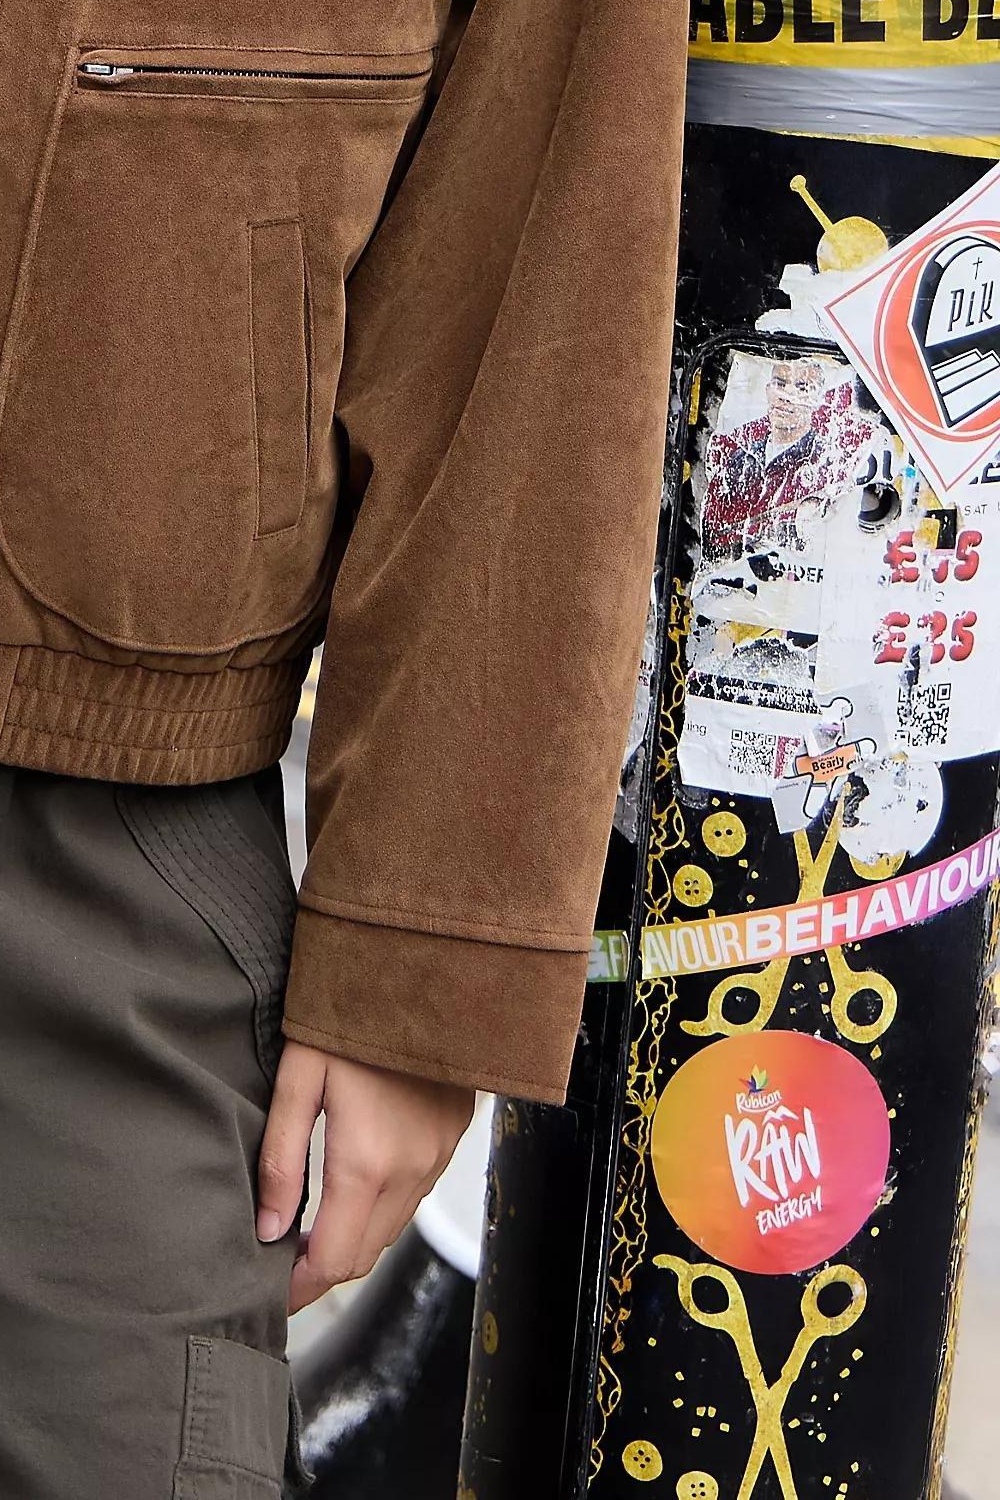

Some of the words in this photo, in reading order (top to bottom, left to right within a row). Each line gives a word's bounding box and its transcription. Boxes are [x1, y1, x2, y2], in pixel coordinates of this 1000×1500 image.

[964, 503, 988, 516] SAT
[811, 755, 845, 773] Bearly
[735, 1089, 783, 1114] Rubicon
[724, 1106, 821, 1208] RAW
[755, 1184, 823, 1236] ENERGY
